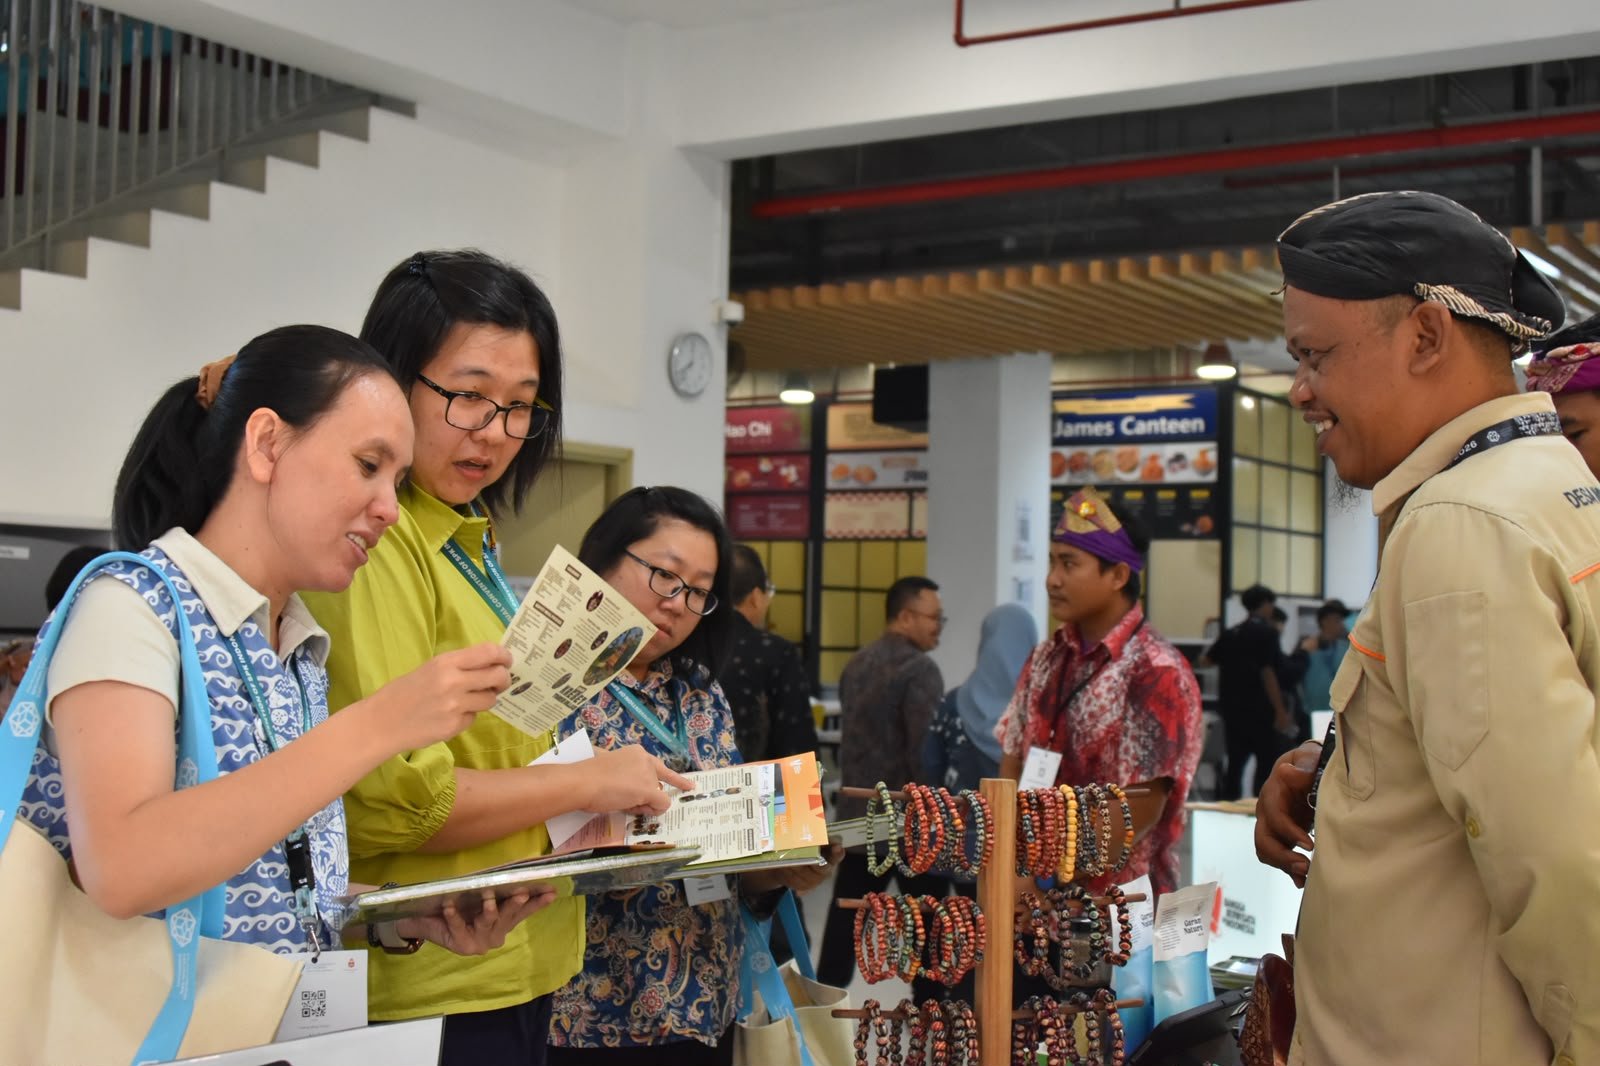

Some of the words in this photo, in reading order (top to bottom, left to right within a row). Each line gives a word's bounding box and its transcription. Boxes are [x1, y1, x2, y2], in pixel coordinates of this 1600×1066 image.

[747, 420, 773, 438] Chi
[1053, 418, 1115, 438] James
[1119, 415, 1206, 435] Canteen
[448, 547, 461, 562] SPK
[458, 560, 469, 570] OF
[466, 569, 502, 608] CONVENTION
[242, 664, 254, 682] SPK
[249, 682, 259, 695] OF
